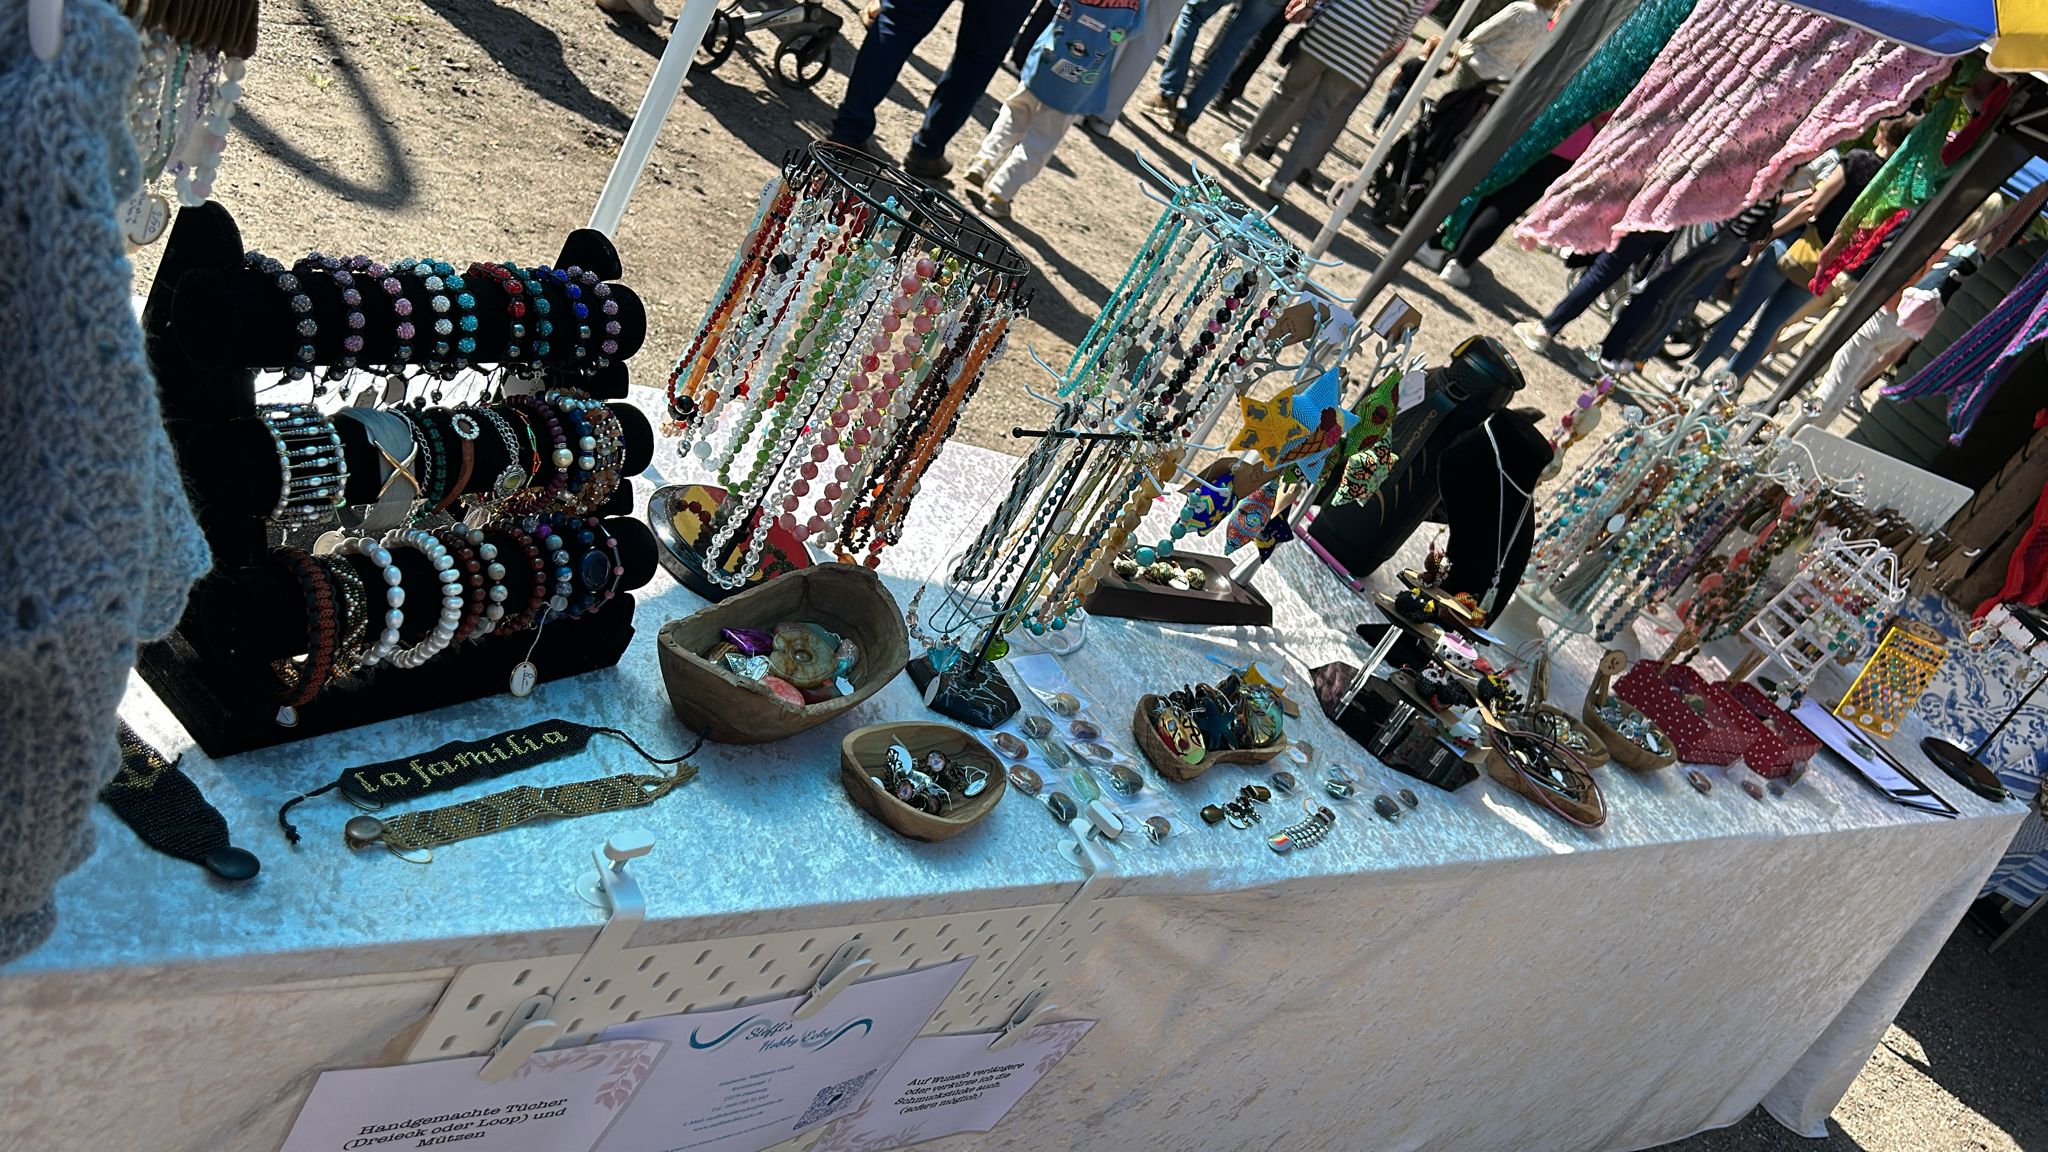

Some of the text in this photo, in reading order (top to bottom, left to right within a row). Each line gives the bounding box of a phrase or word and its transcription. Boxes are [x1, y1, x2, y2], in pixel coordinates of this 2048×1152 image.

[409, 729, 568, 788] familia
[757, 1036, 799, 1053] Hobby
[904, 1087, 932, 1096] oder
[978, 1075, 995, 1083] ich
[994, 1072, 1011, 1080] die
[906, 1077, 932, 1086] Auf
[931, 1071, 971, 1084] Wunsch
[894, 1087, 976, 1105] Schmuckstücke
[899, 1091, 983, 1115] (sofern möglich)
[342, 1107, 567, 1151] (Dreieck oder Loop) und
[356, 1098, 568, 1136] Handgemachte Tücher
[415, 1130, 486, 1149] Mützen
